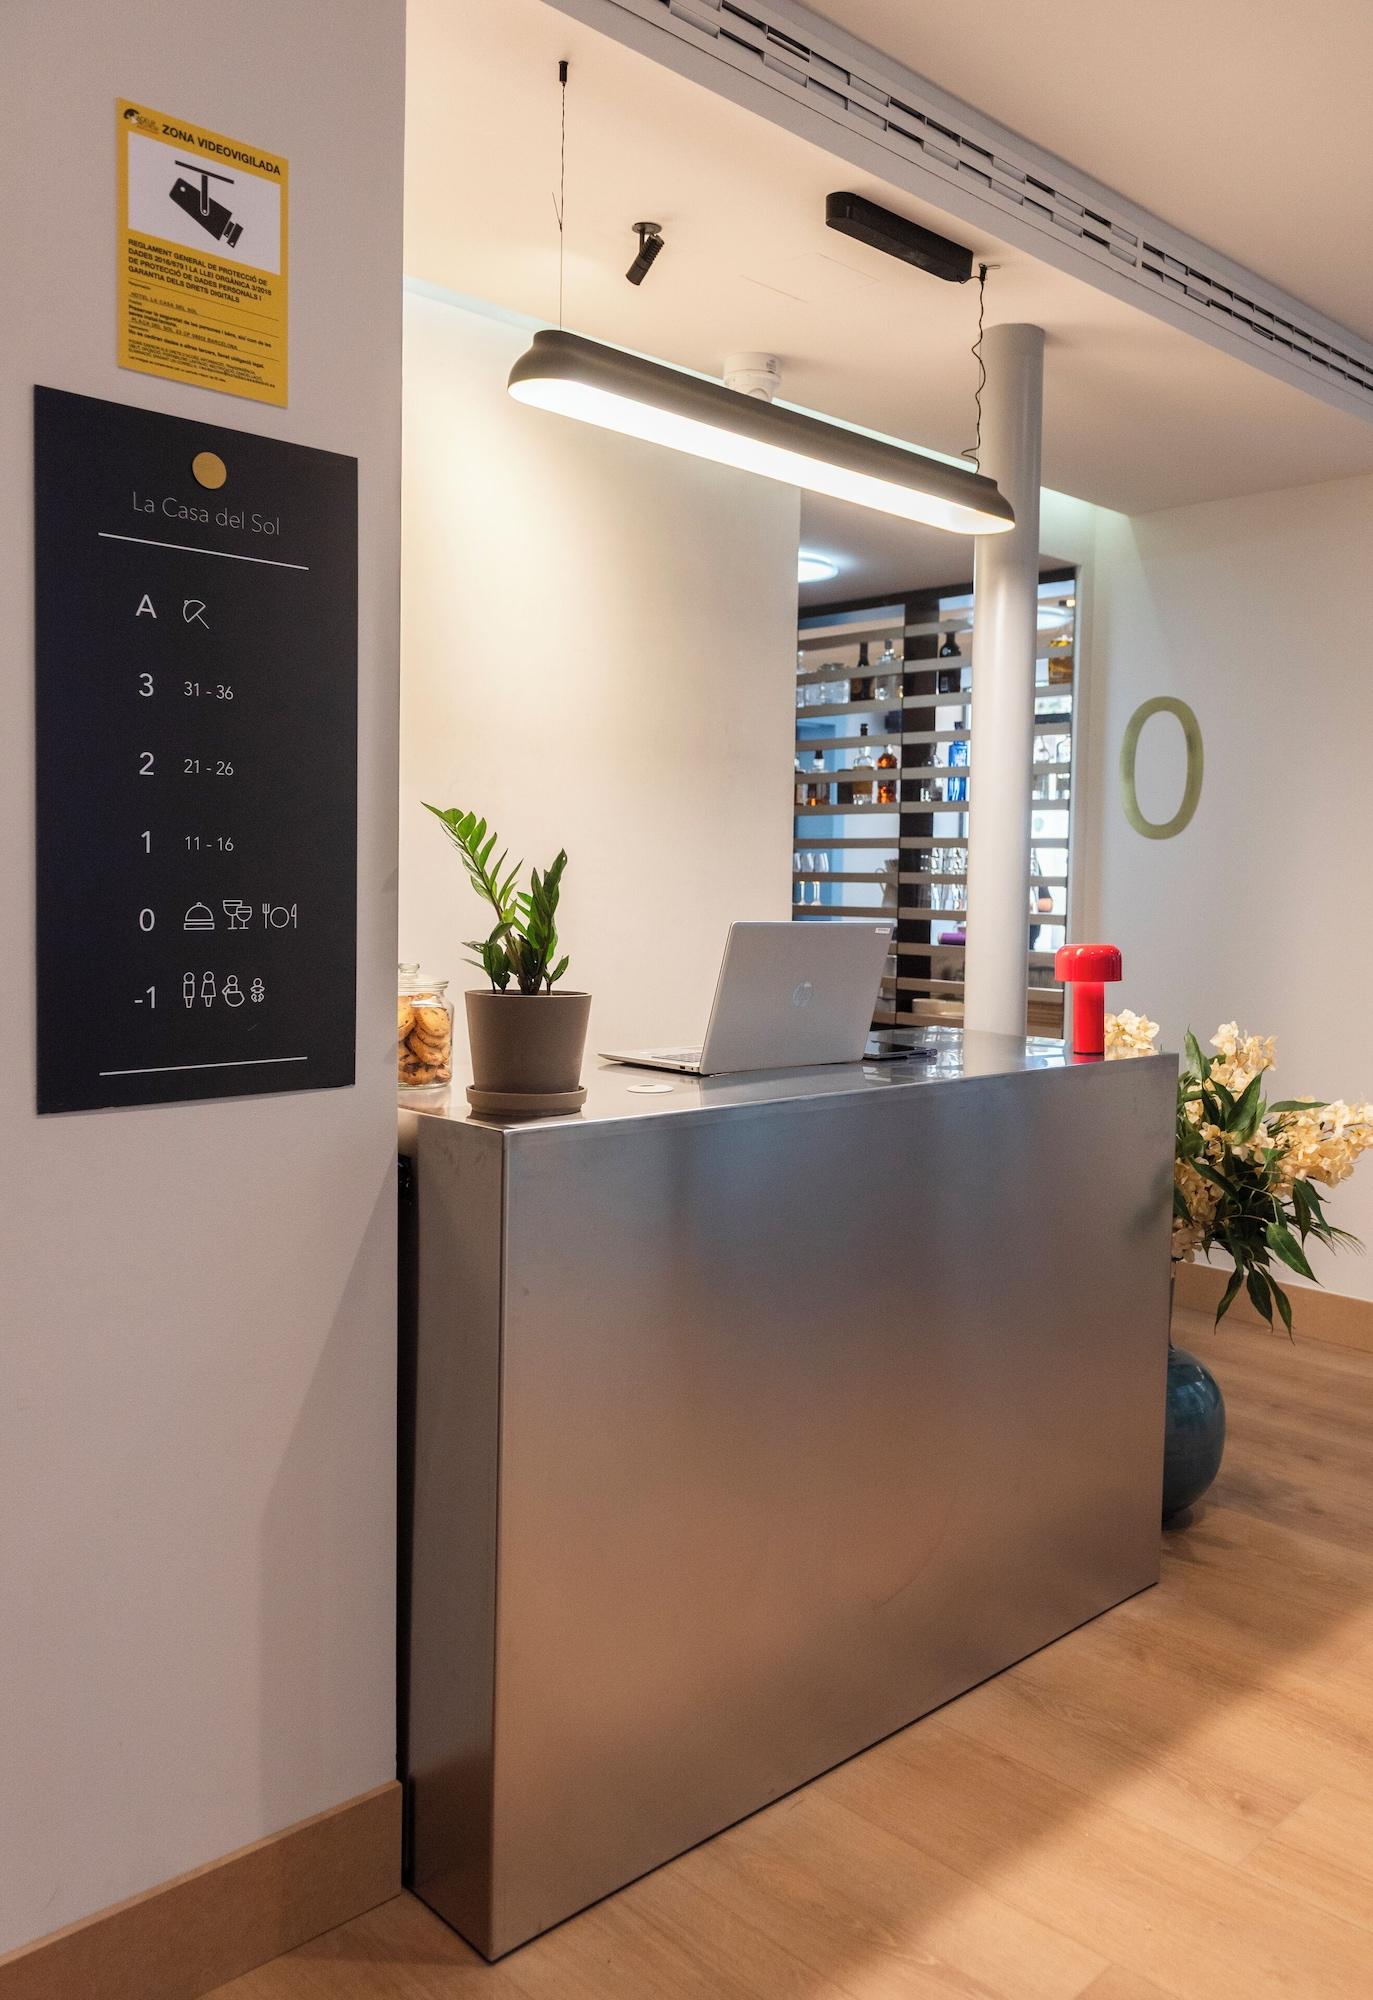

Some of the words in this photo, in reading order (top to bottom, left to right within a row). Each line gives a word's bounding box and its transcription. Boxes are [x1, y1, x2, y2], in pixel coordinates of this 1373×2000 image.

[162, 123, 194, 145] ZONA
[197, 136, 280, 176] VIDEOVIGILADA
[128, 238, 171, 257] REGLAMENT
[174, 252, 205, 267] GENERAL
[208, 262, 216, 271] DE
[218, 265, 256, 282] PROTECCIÓ
[258, 278, 266, 286] DE
[128, 247, 152, 260] DADES
[189, 265, 197, 274] LA
[199, 268, 213, 278] LLEI
[215, 272, 249, 289] ORGÀNICA
[251, 284, 271, 295] 3/2018
[128, 256, 137, 265] DE
[140, 258, 180, 277] PROTECCIÓ
[183, 272, 191, 280] DE
[194, 275, 216, 288] DADES
[218, 282, 257, 300] PERSONALS
[128, 265, 163, 281] GARANTIA
[166, 276, 183, 287] DELS
[186, 282, 208, 294] DRETS
[210, 289, 239, 303] DIGITALS
[132, 491, 155, 513] La
[161, 497, 209, 523] Casa
[215, 507, 245, 530] del
[251, 513, 280, 536] Sol
[135, 593, 157, 619] A
[139, 672, 154, 697] 3
[183, 681, 200, 697] 31
[216, 684, 234, 701] 36
[139, 752, 154, 775] 2
[184, 758, 200, 773] 21
[216, 759, 234, 776] 26
[141, 831, 150, 853] 1
[139, 908, 155, 932] 0
[134, 986, 155, 1009] -1
